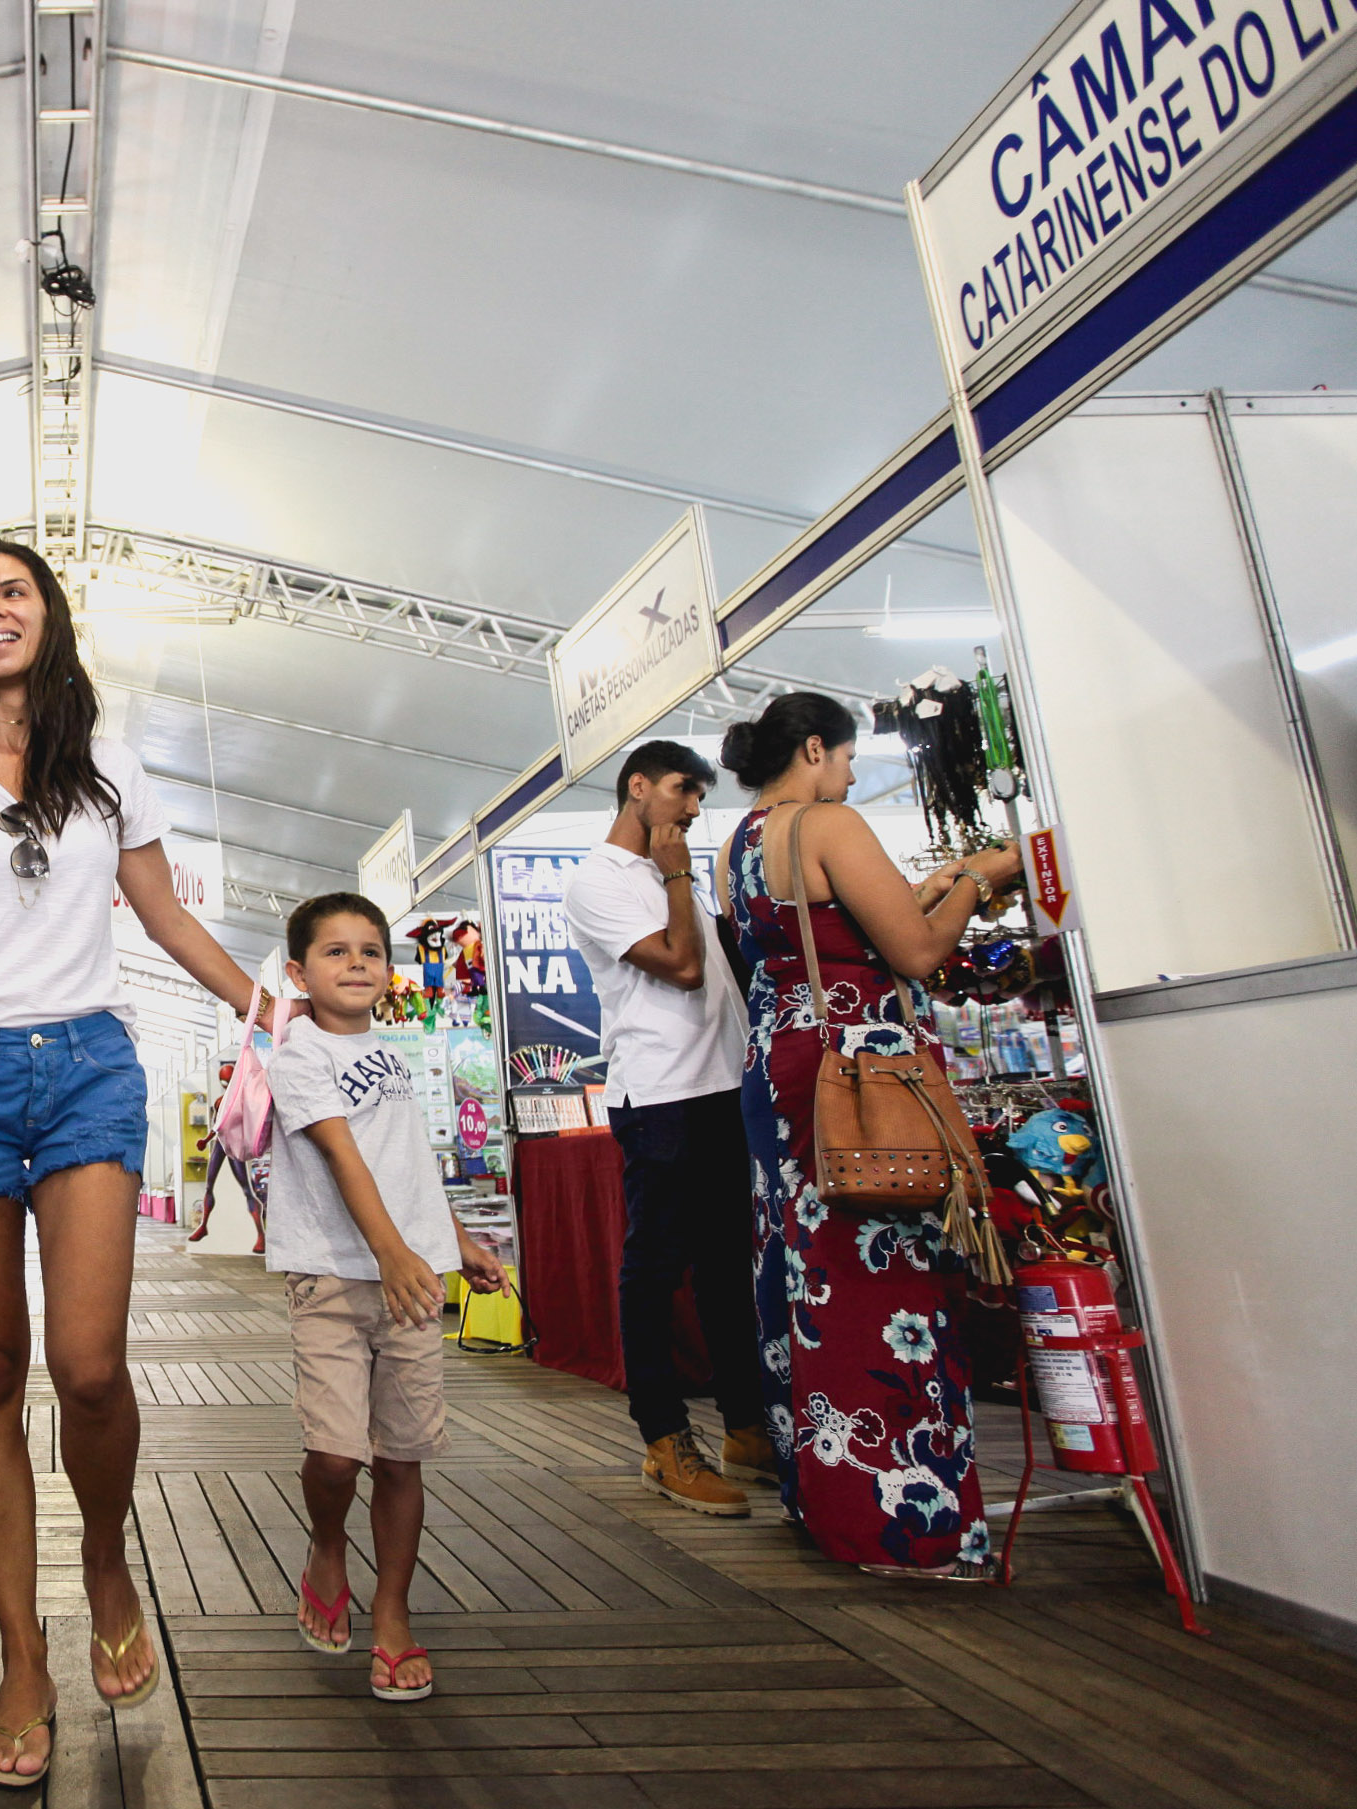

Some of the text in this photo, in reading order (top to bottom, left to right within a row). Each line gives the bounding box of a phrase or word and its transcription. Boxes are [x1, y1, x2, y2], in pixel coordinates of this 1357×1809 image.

[959, 76, 1203, 351] CATARINENSE
[1198, 11, 1275, 133] DO
[567, 604, 699, 738] CANETAS PERSONALIZADAS
[174, 862, 204, 905] 2018
[1036, 837, 1057, 903] EXTINTOR
[506, 956, 577, 993] NA
[460, 1115, 486, 1134] 10,00
